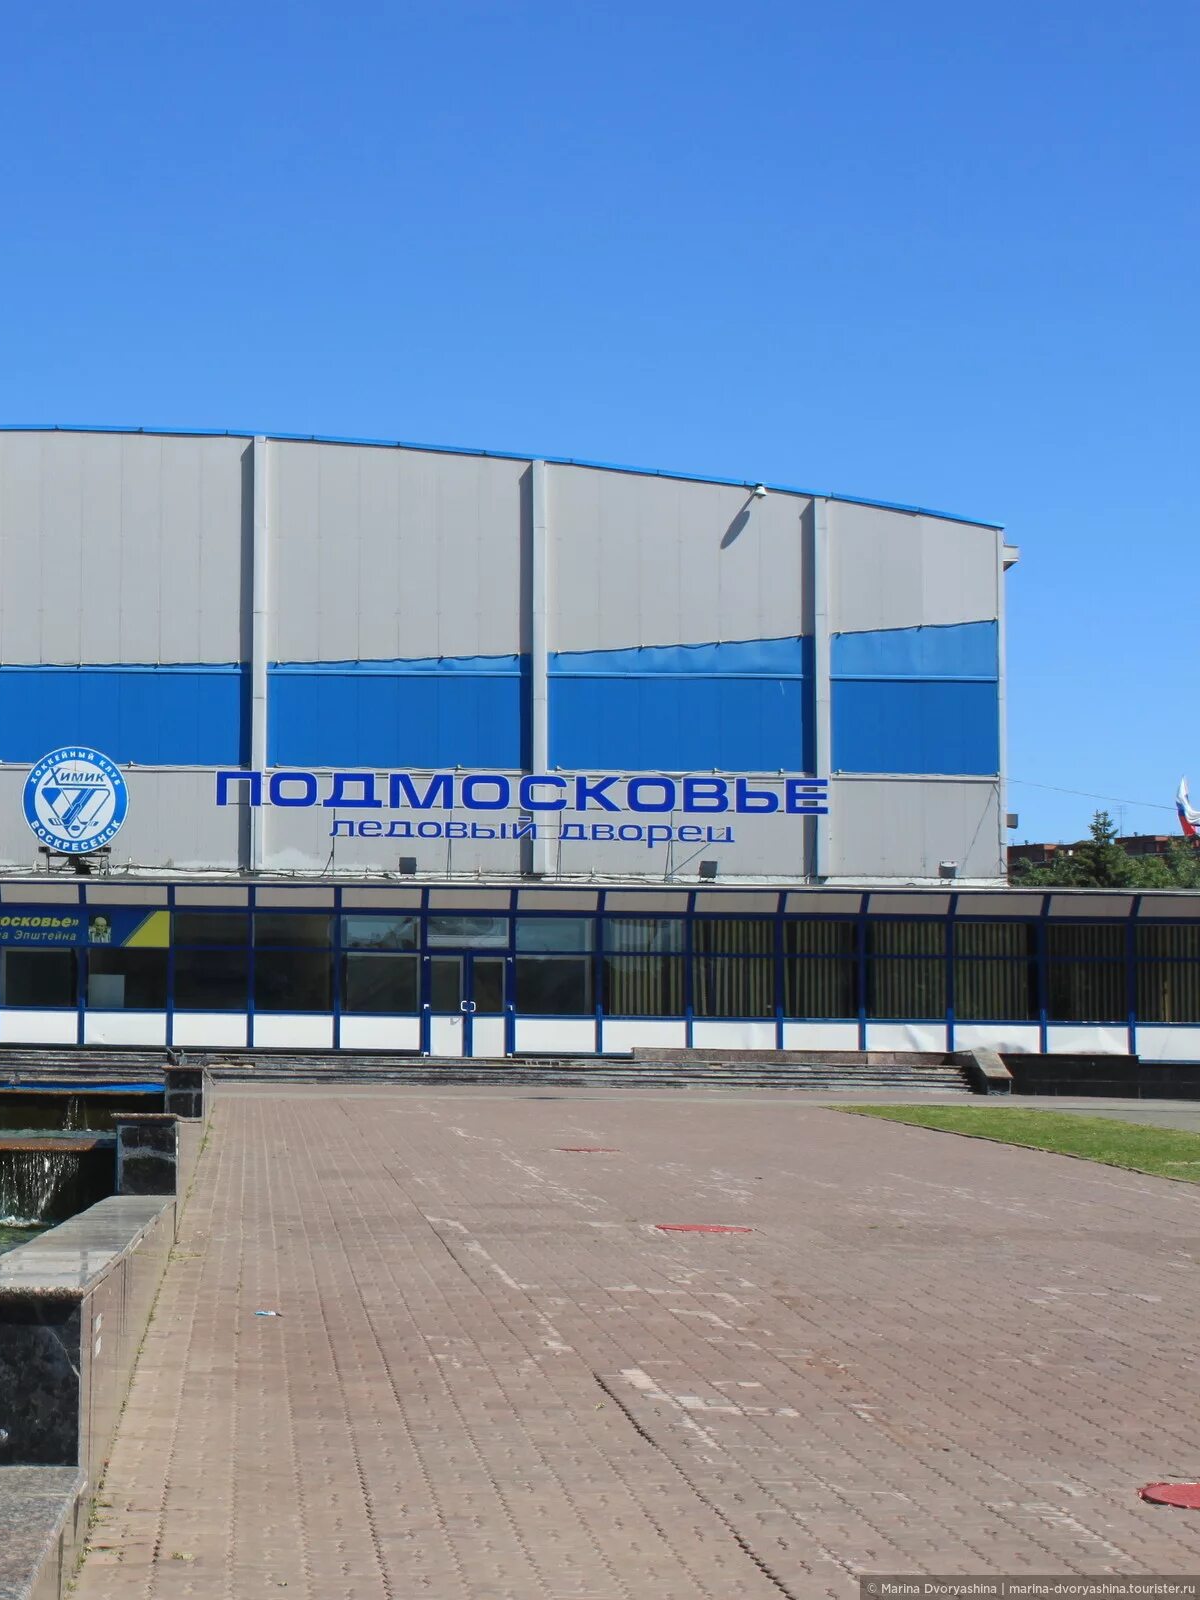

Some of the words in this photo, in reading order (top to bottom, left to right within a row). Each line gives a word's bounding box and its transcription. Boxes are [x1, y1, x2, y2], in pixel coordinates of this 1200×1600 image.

[31, 751, 94, 784] ХОККЕЙНЫЙ
[99, 760, 121, 786] КЛУБ
[216, 770, 829, 815] ПОДМОСКОВЬЕ
[31, 820, 121, 851] ВОСКРЕСЕНСК
[328, 816, 538, 840] ледовый
[558, 823, 736, 849] дворец
[14, 929, 77, 941] Эпштейна
